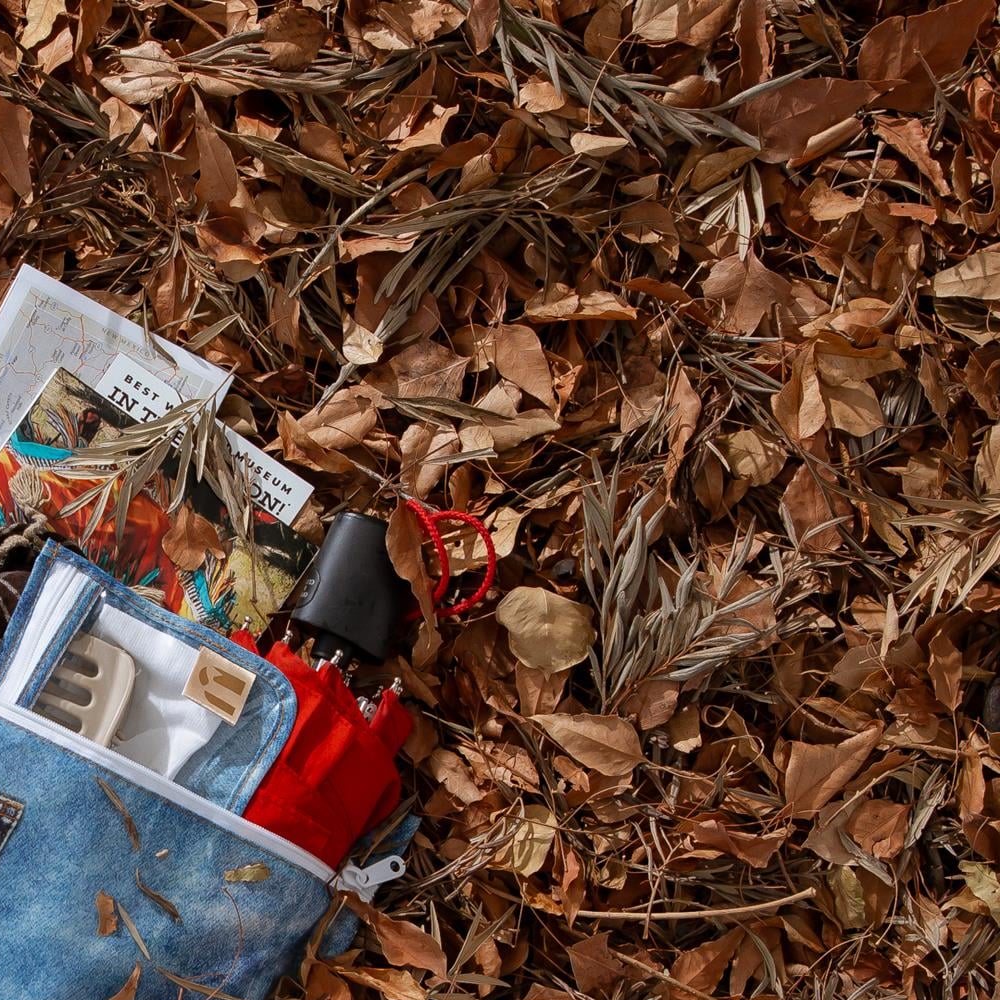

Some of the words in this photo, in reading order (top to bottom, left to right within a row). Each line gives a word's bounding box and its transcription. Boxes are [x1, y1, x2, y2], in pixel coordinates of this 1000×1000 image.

[124, 374, 160, 401] BEST
[107, 386, 139, 412] IN
[140, 406, 184, 446] TE
[235, 451, 292, 495] MUSEUM
